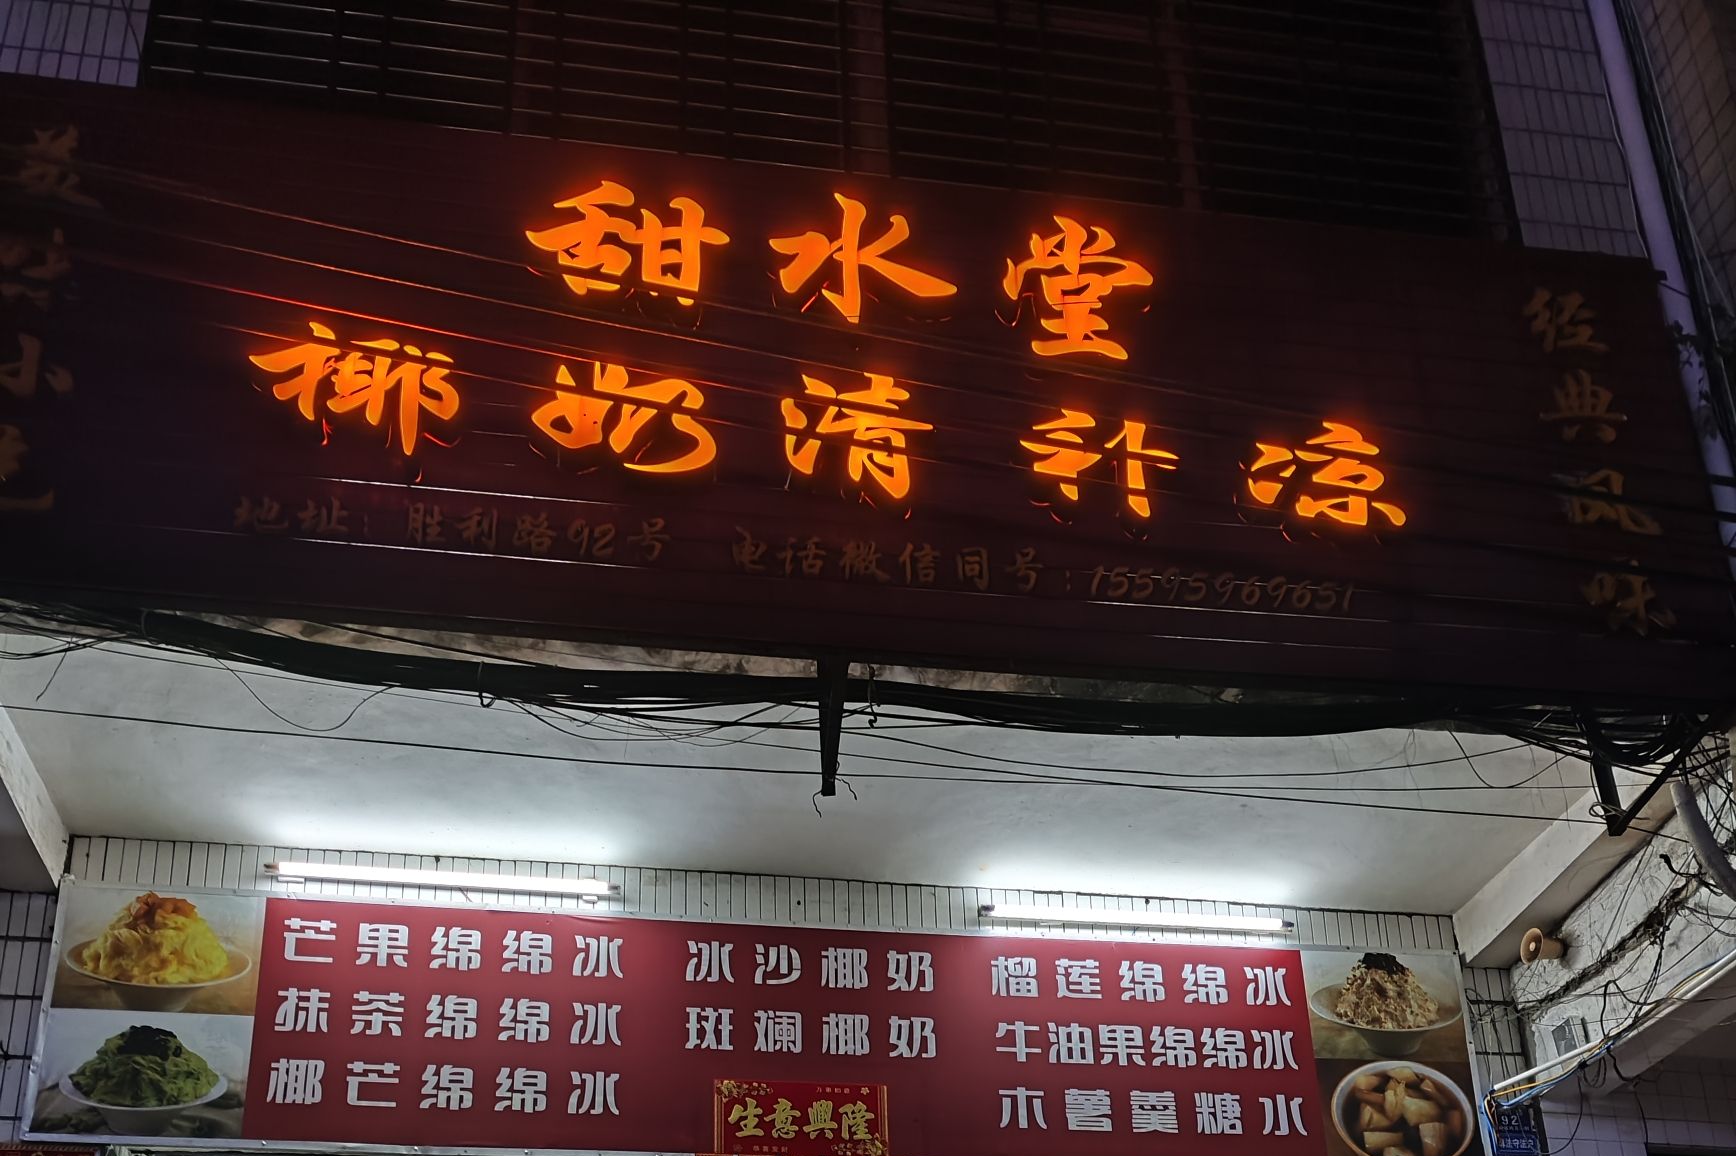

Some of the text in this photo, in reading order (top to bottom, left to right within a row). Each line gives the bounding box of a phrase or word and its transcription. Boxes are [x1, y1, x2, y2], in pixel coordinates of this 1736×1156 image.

[526, 180, 1153, 361] 甜水堂
[284, 917, 625, 979] 芒果绵绵冰
[686, 939, 935, 993] 冰沙椰奶
[991, 956, 1294, 1006] 榴莲绵绵冰
[275, 987, 622, 1046] 抹茶绵绵冰
[686, 1007, 937, 1059] 斑斓椰奶
[996, 1021, 1299, 1071] 牛油果绵绵冰
[267, 1058, 620, 1115] 椰芒绵绵冰
[999, 1086, 1308, 1136] 木薯羹糖水
[727, 1097, 875, 1141] 生意興隆
[1501, 1115, 1519, 1126] 92
